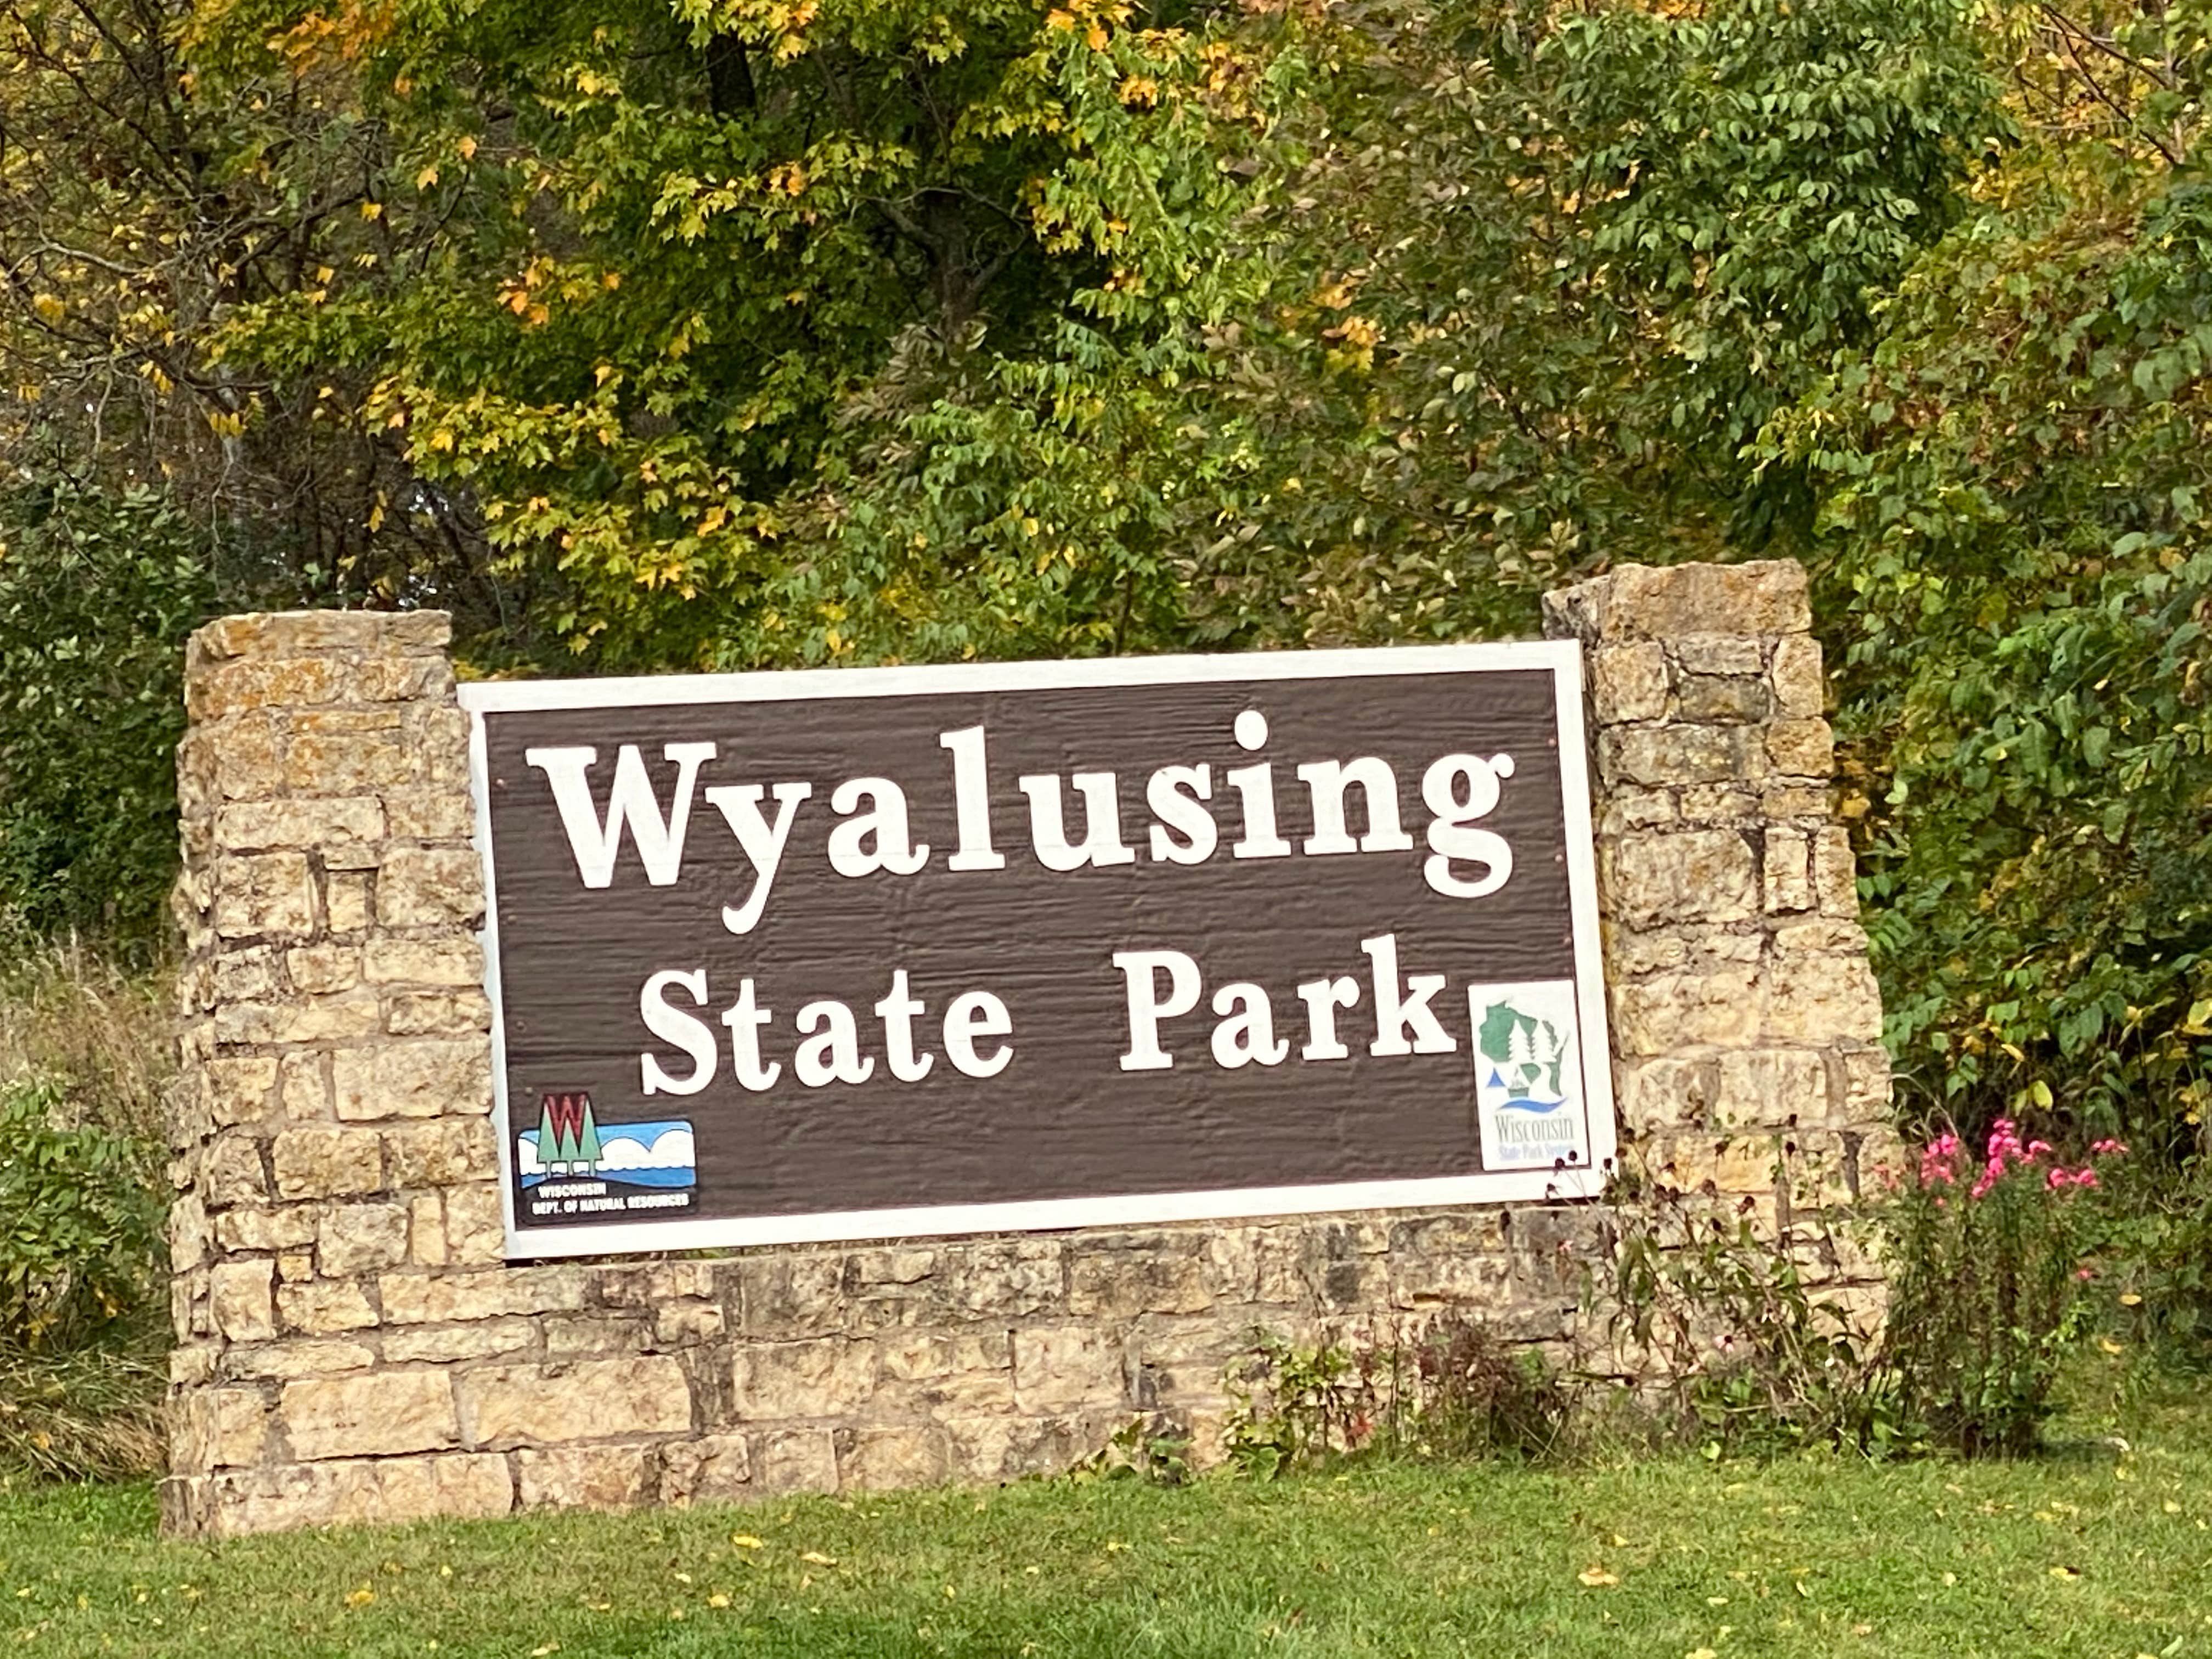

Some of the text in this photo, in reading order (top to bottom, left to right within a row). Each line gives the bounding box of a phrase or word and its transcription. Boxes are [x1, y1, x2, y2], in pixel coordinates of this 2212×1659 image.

[524, 709, 1515, 934] Wyalusing
[640, 933, 1458, 1096] State Park
[1495, 1112, 1574, 1143] Wisconsin
[532, 1193, 690, 1215] DEPT. OF NATURAL RESOURCES
[538, 1183, 606, 1198] WISCONSIN
